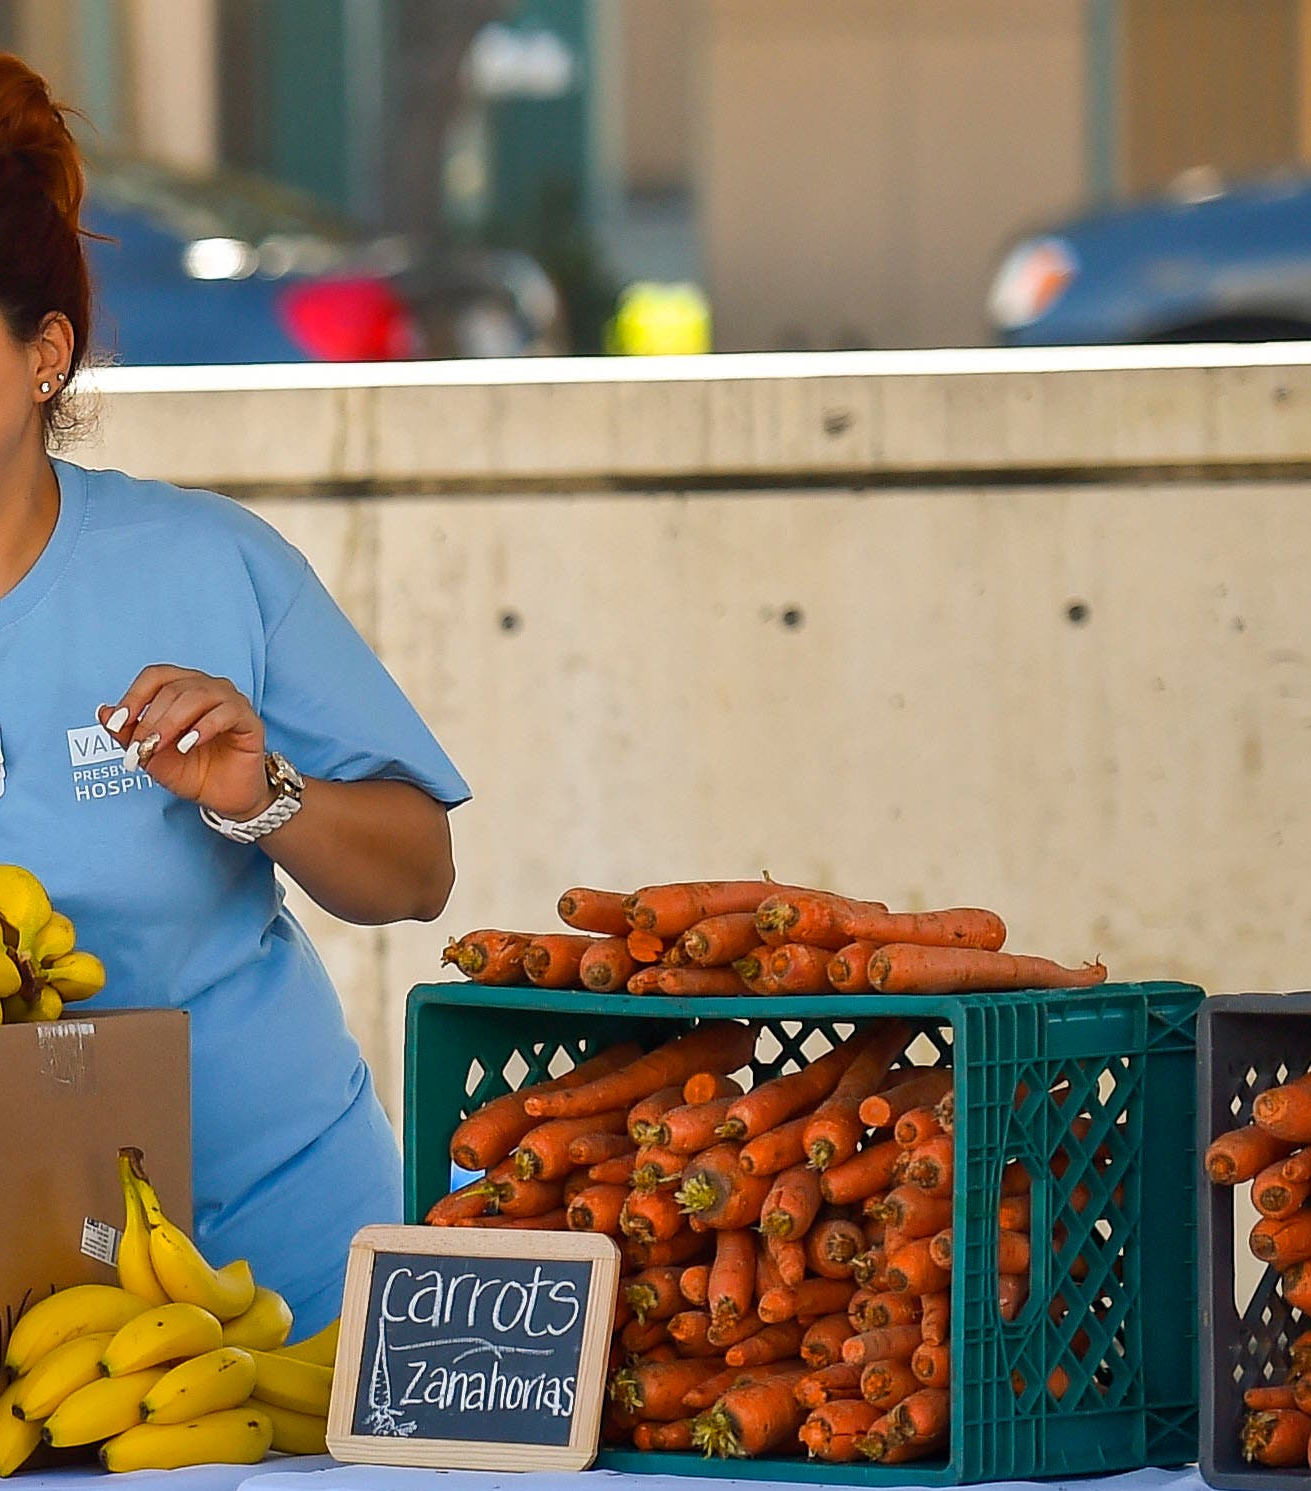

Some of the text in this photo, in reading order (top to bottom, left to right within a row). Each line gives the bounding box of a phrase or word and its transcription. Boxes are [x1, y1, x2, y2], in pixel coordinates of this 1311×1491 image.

[74, 735, 121, 757] VAL
[73, 765, 145, 783] PRESBY
[75, 774, 153, 802] HOSPIT
